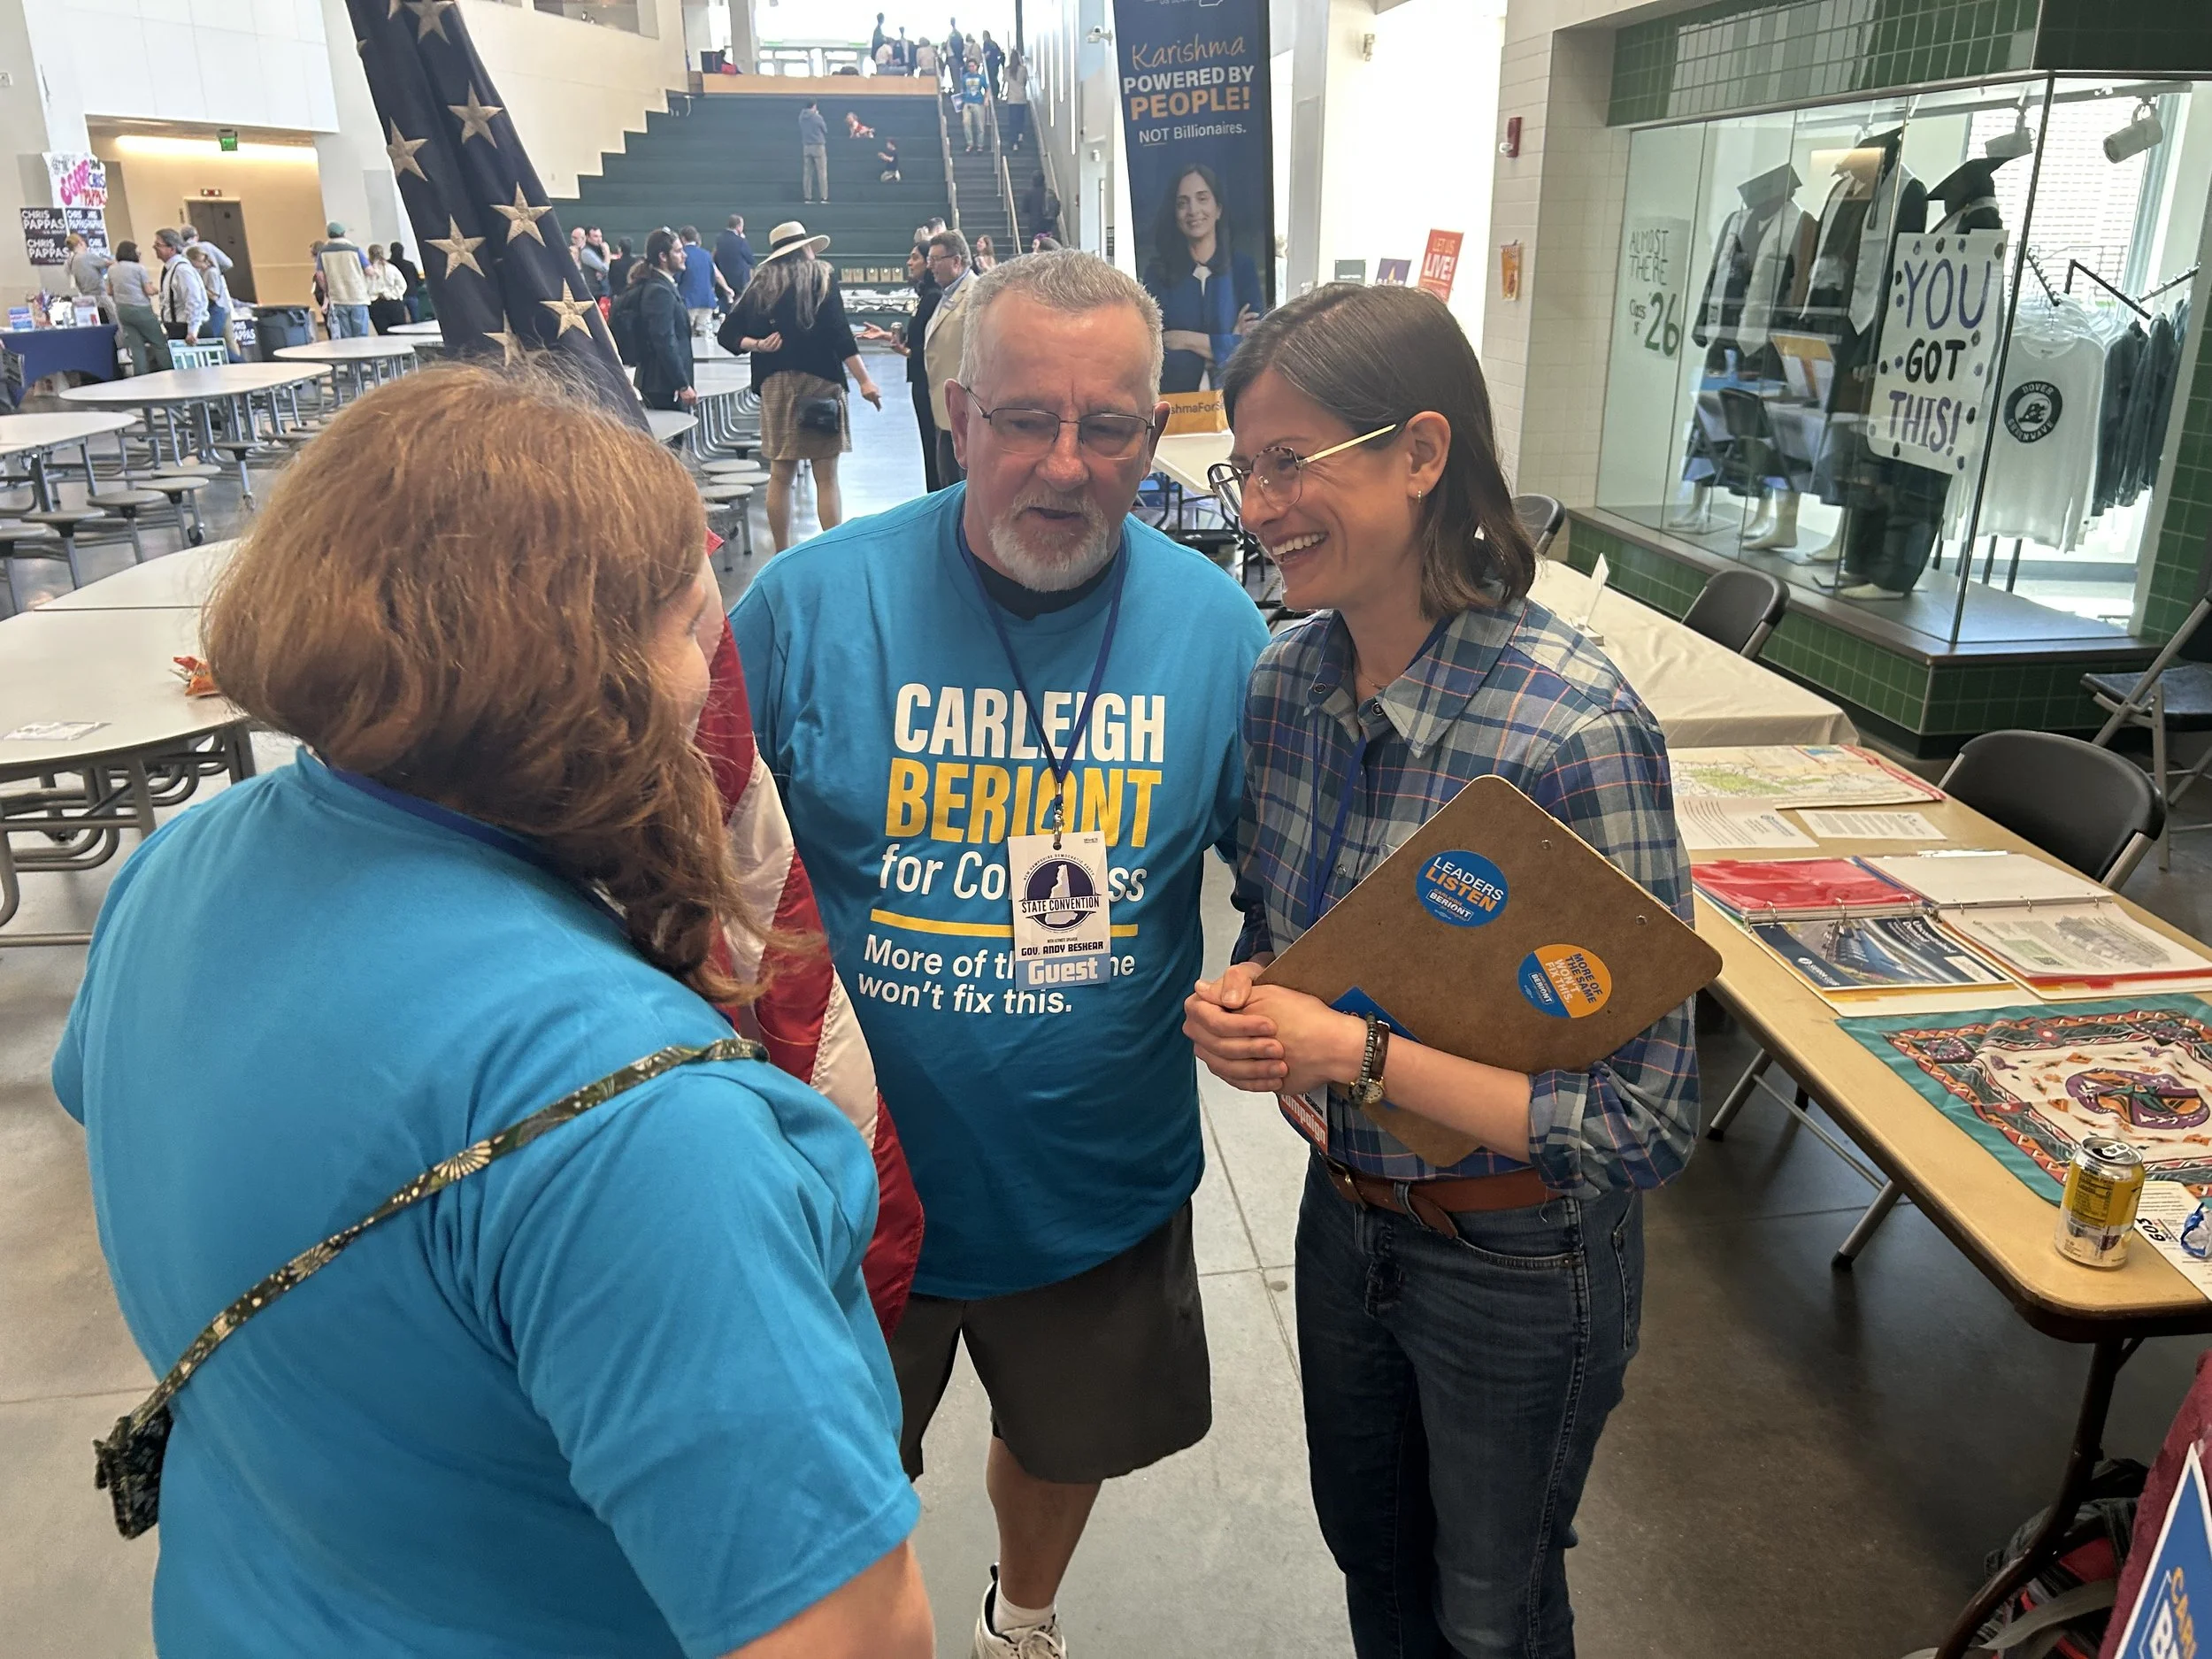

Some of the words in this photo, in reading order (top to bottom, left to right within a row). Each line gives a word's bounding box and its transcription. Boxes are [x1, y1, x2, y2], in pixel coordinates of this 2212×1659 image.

[1132, 33, 1246, 71] Karishma
[1124, 66, 1225, 94] POWERED
[1228, 65, 1255, 83] BY
[1130, 86, 1250, 120] PEOPLE!
[1139, 127, 1170, 143] NOT
[1173, 120, 1247, 140] Billionaires.
[21, 210, 50, 220] CHRIS
[24, 219, 65, 230] PAPPAS
[27, 237, 55, 248] CHRIS
[28, 247, 70, 259] PAPPAS
[1629, 228, 1670, 257] ALMOST
[1424, 252, 1455, 280] LIVE!
[1629, 254, 1668, 286] THERE
[1903, 257, 1991, 330] YOU
[1905, 337, 1966, 384] GOT
[2022, 383, 2054, 395] DOVER
[1889, 389, 1962, 457] THIS!
[894, 682, 1165, 763] CARLEIGH
[885, 757, 1163, 849] BERIONT
[879, 843, 944, 895] for
[952, 850, 1148, 902] Coss
[1432, 856, 1504, 901] LEADERS
[1021, 900, 1047, 913] STATE
[1048, 895, 1100, 911] CONVENTION
[1425, 866, 1498, 912] LISTEN
[1429, 892, 1471, 918] BERIONT
[863, 933, 943, 975] More
[952, 949, 988, 979] of
[1021, 947, 1041, 956] GOV.
[1043, 944, 1065, 955] ANDY
[1068, 941, 1104, 952] BESHEAR
[1028, 956, 1098, 985] Guest
[1545, 961, 1560, 978] FIX
[1554, 958, 1580, 993] WON'T
[1565, 956, 1580, 976] THE
[1576, 976, 1597, 1003] SAME
[1572, 953, 1594, 982] MORE
[1590, 982, 1603, 995] OF
[857, 972, 944, 1010] won't
[953, 984, 994, 1015] fix
[1003, 988, 1072, 1015] this.
[1531, 973, 1553, 1003] BERIONT
